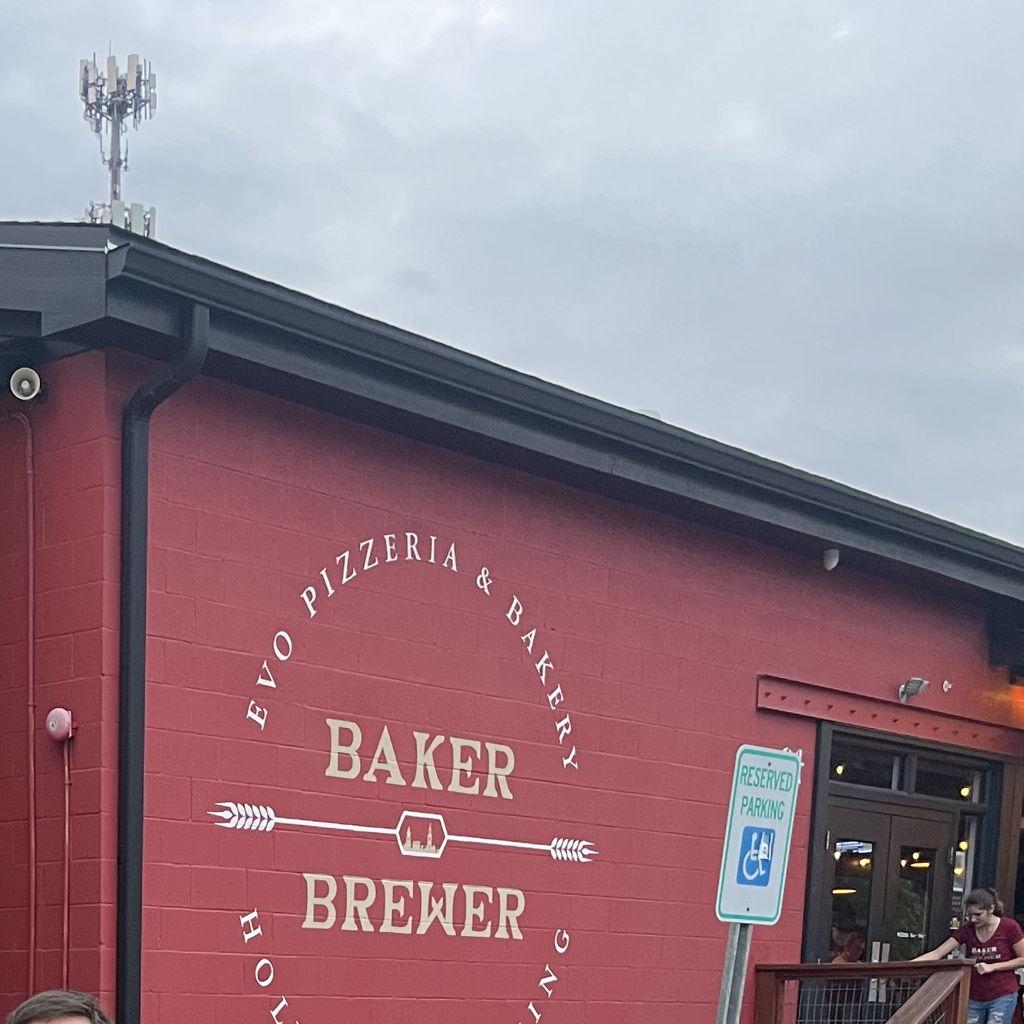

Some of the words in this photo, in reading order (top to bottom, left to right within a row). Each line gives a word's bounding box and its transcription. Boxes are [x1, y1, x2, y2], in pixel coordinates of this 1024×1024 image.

[246, 631, 293, 730] EVO
[300, 532, 458, 617] PIZZERIA
[476, 567, 493, 595] &
[506, 596, 578, 770] BAKERY
[325, 718, 515, 800] BAKER
[739, 765, 793, 792] RESERVED
[740, 796, 784, 820] PARKING
[301, 872, 526, 940] BREWER
